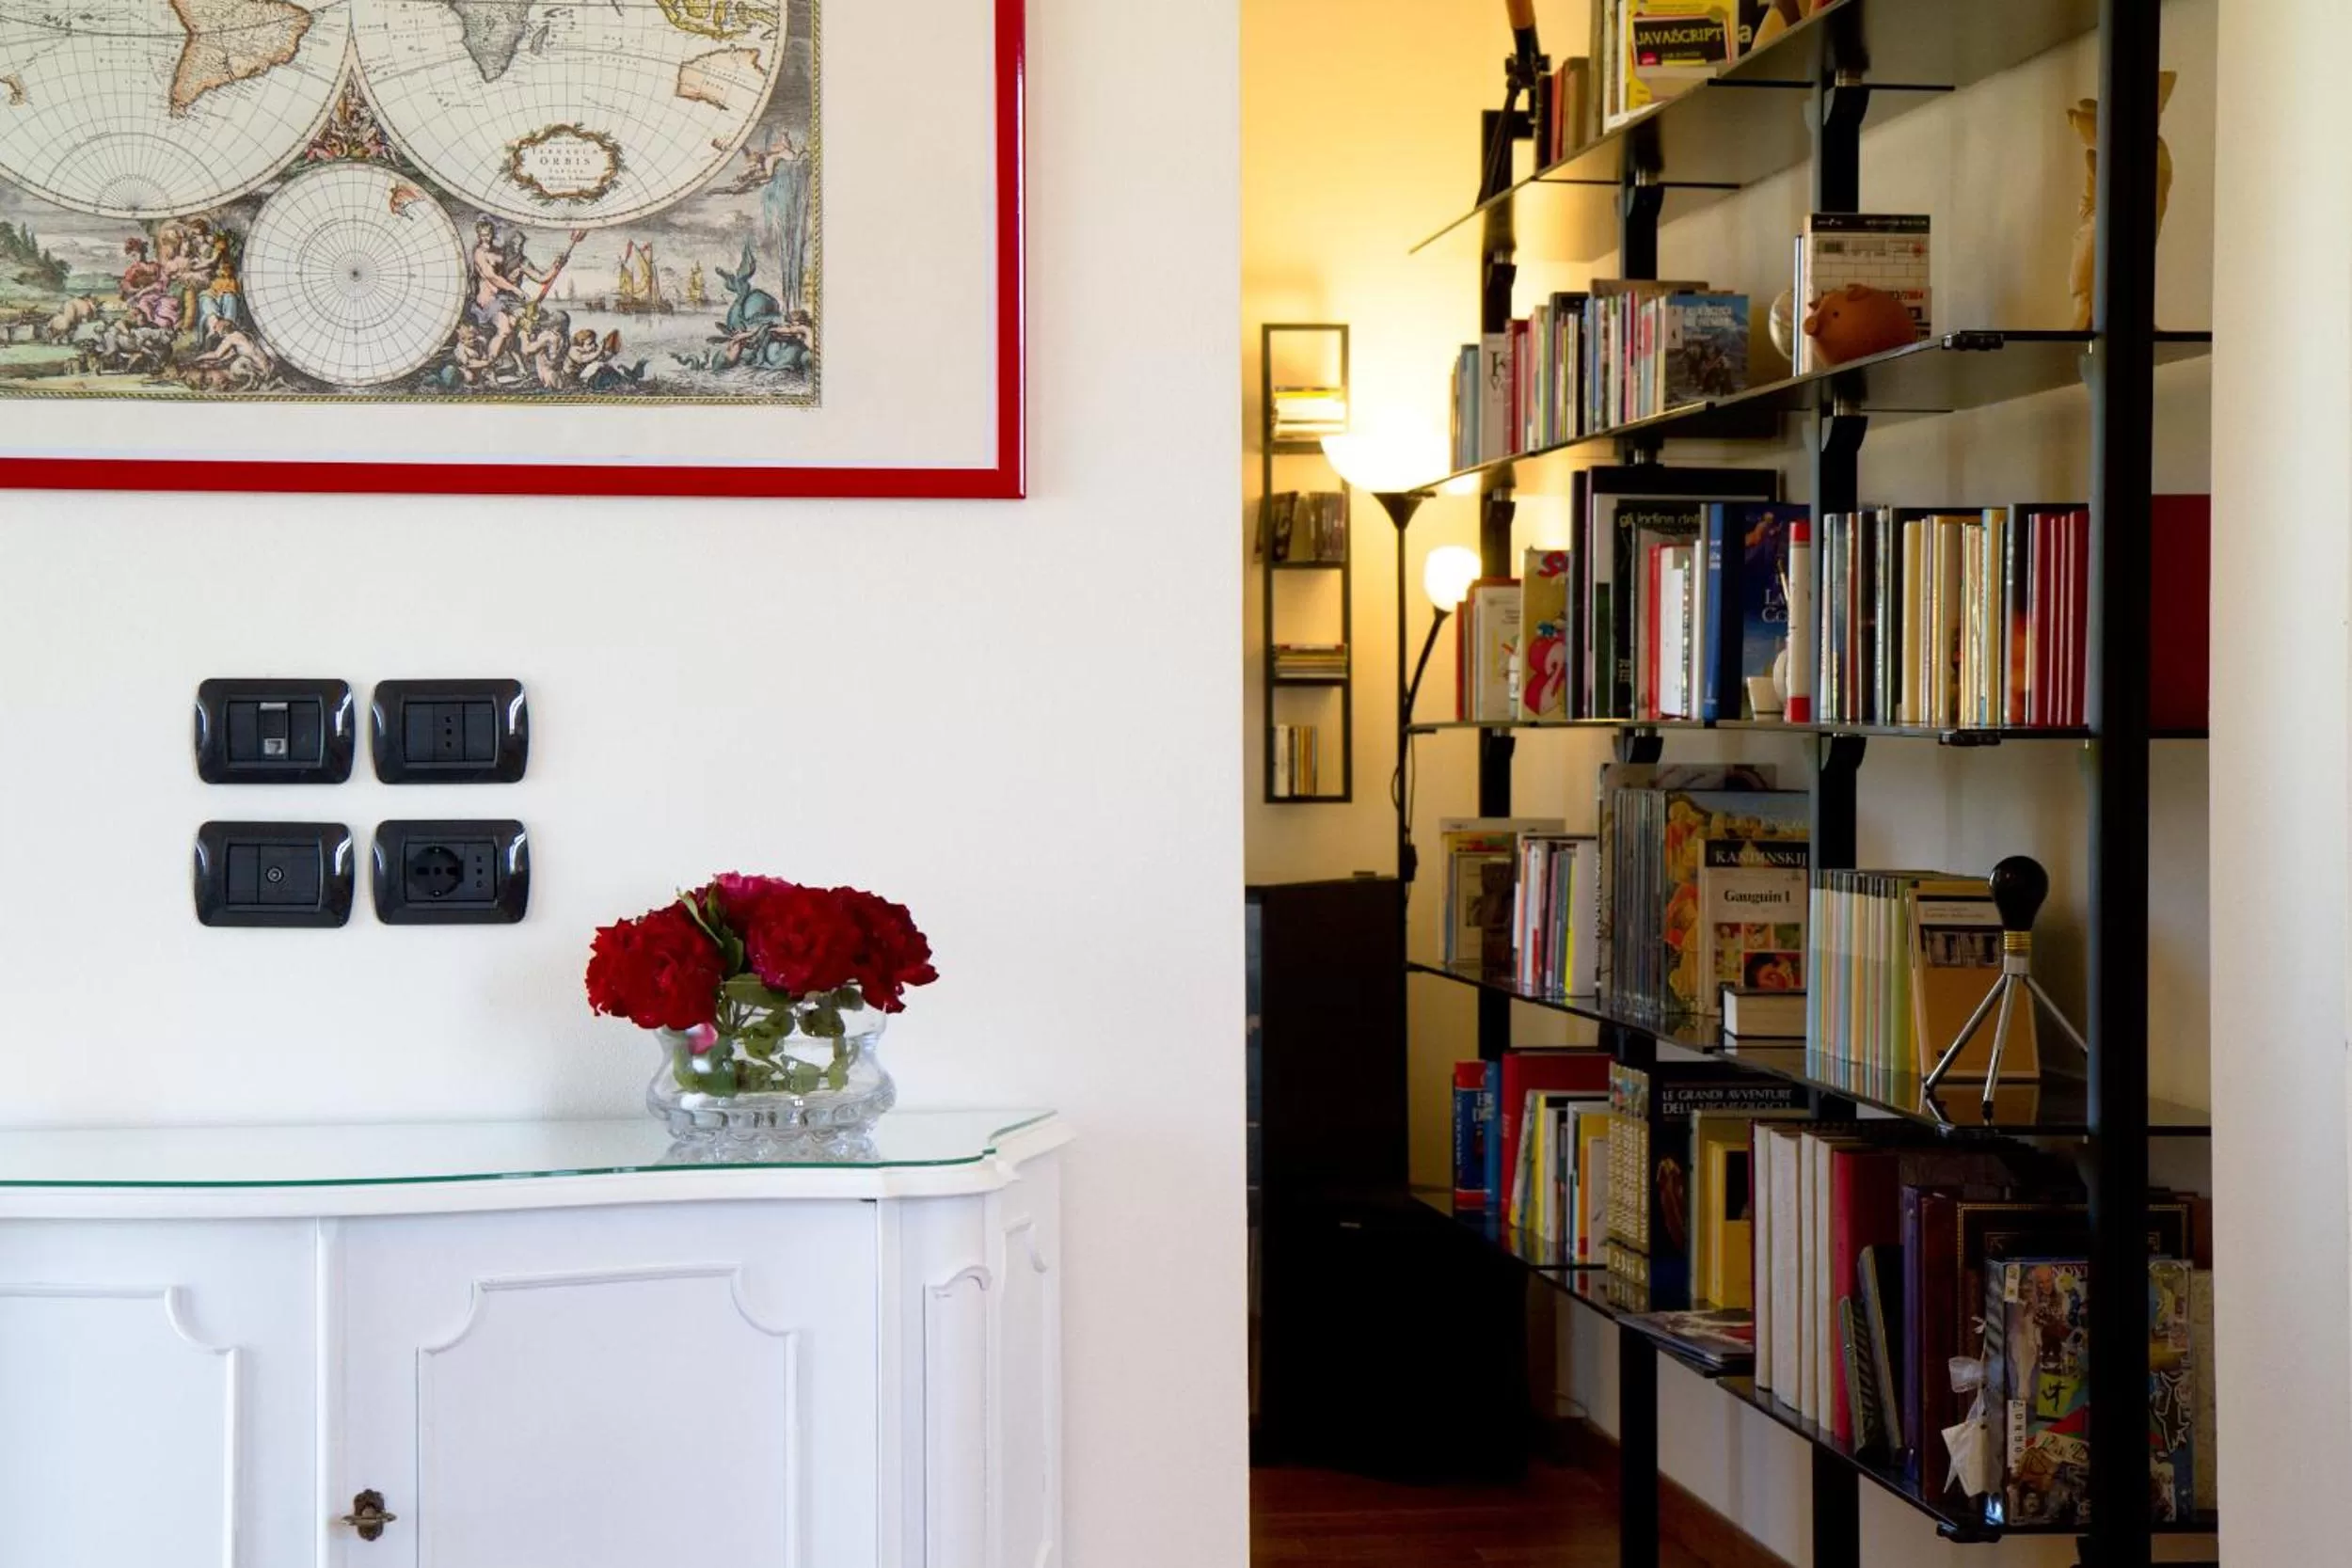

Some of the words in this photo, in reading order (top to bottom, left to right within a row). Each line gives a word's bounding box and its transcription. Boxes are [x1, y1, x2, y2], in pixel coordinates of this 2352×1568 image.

[1636, 26, 1724, 46] JAVASCRIPT
[539, 156, 591, 166] ORBIS
[1715, 849, 1806, 866] KANDINSKIJ
[1724, 889, 1782, 904] Gauguin
[1661, 1089, 1675, 1101] LE
[1678, 1089, 1724, 1101] GRANDI
[1726, 1088, 1792, 1100] AVVENTURE
